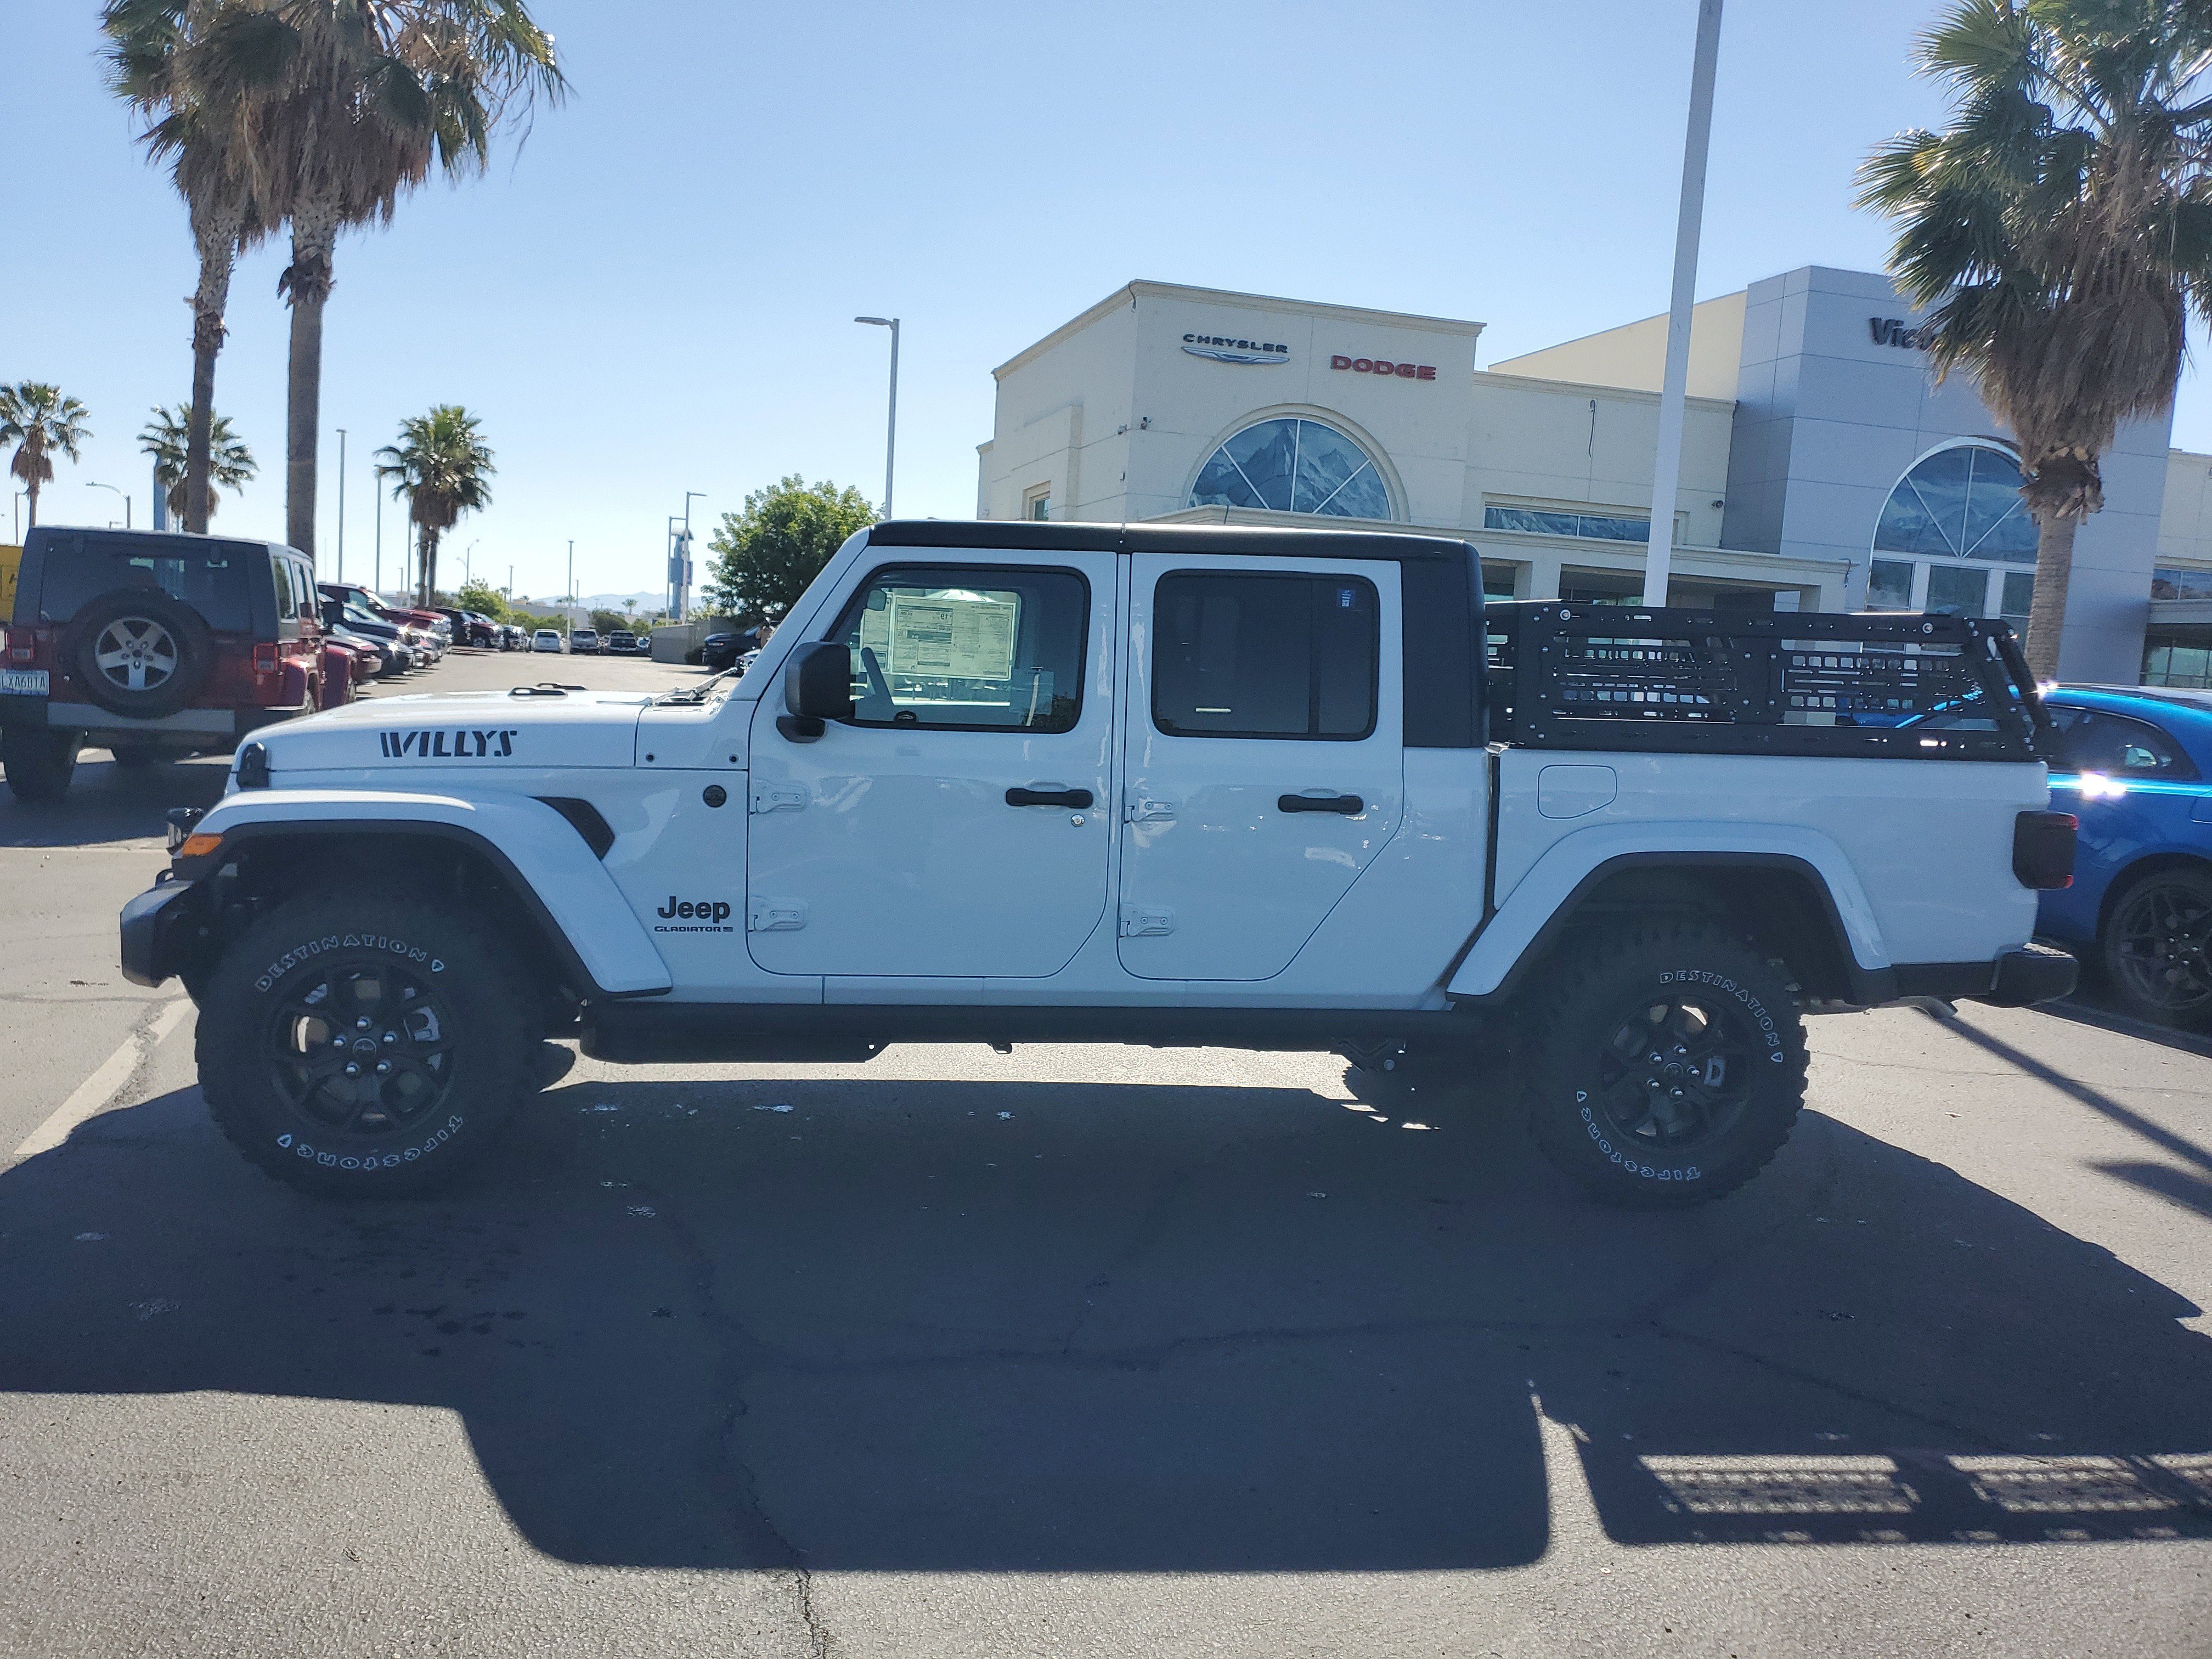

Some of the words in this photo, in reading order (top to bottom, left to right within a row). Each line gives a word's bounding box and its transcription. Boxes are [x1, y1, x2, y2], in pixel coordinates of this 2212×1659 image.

[1183, 334, 1288, 353] CHRYSLER
[1331, 354, 1437, 380] DODGE
[380, 730, 517, 758] WILLYS
[657, 896, 730, 924] Jeep
[255, 934, 427, 992] DESTINATION
[1660, 970, 1780, 1047] DESTINATION
